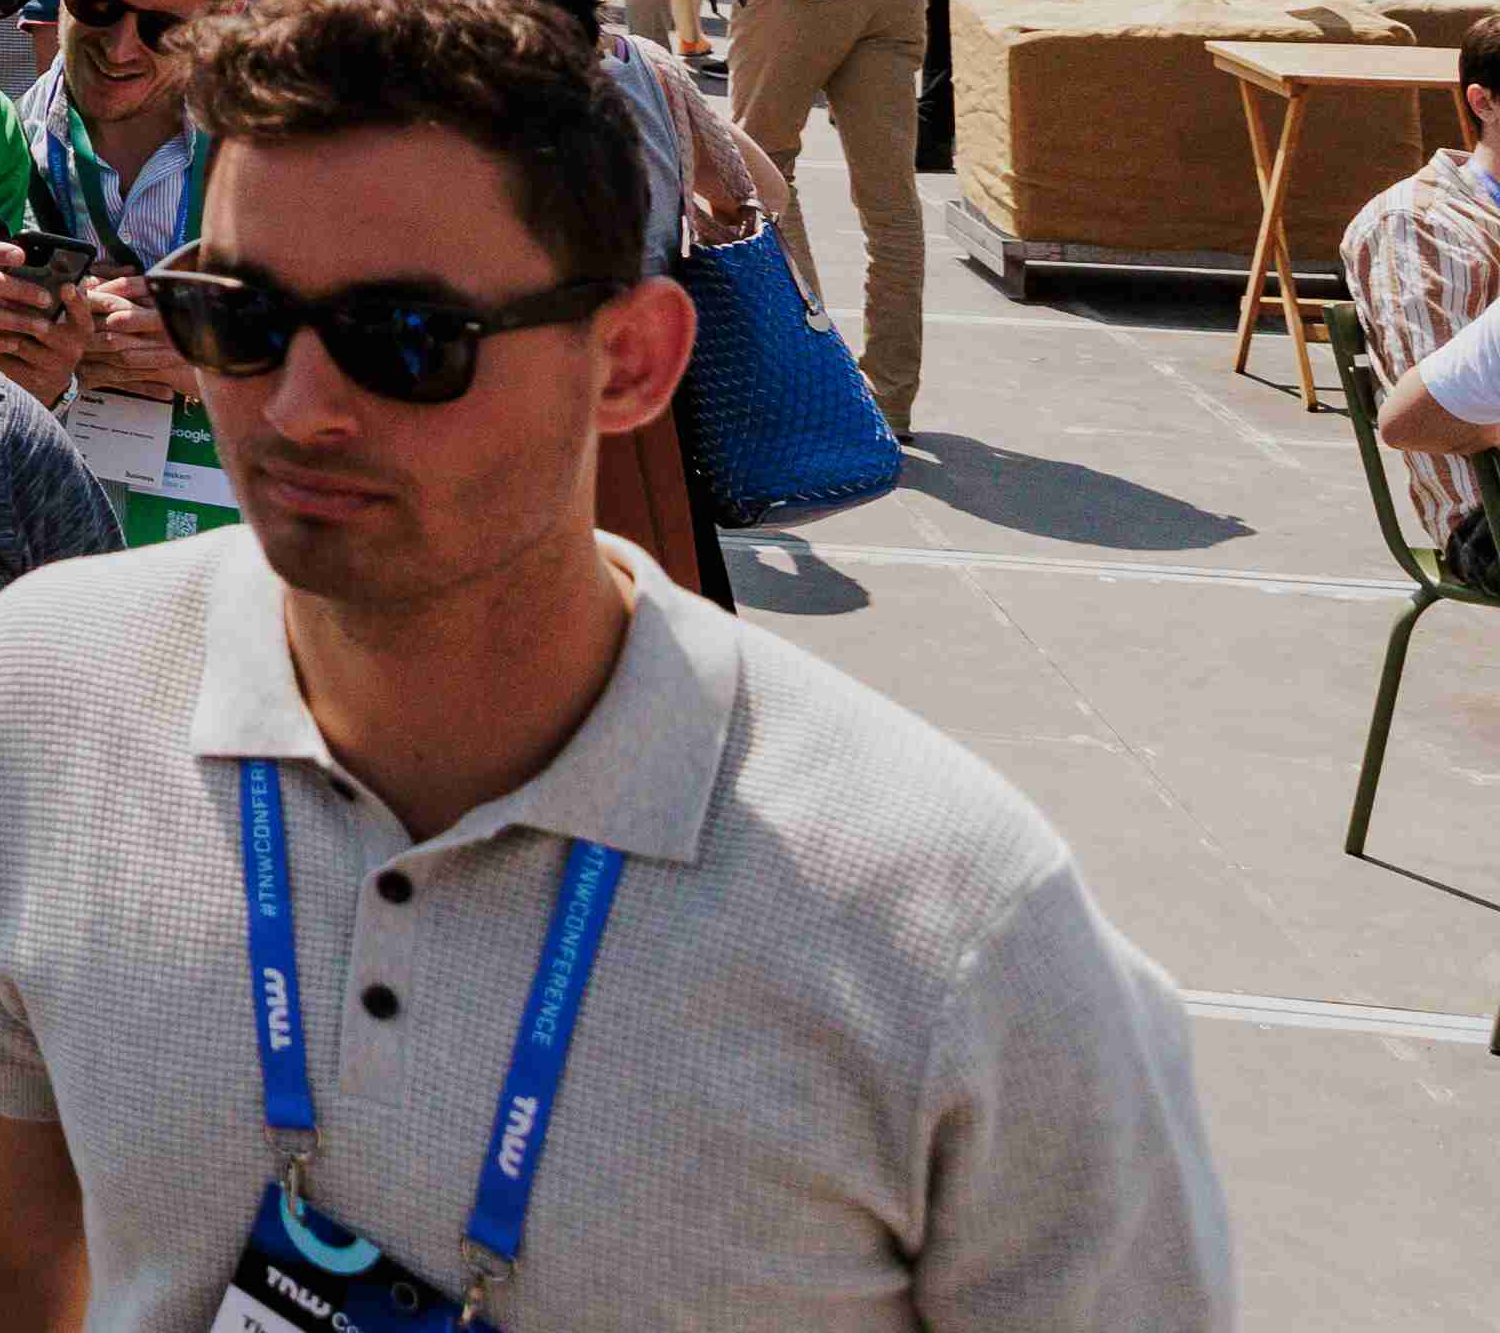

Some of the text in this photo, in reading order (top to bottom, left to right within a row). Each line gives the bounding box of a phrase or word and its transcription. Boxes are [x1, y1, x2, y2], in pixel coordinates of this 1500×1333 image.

[245, 764, 281, 918] #TNWCONFER
[263, 967, 293, 1052] TNW
[499, 1095, 539, 1179] TNW
[266, 1265, 332, 1318] TNW
